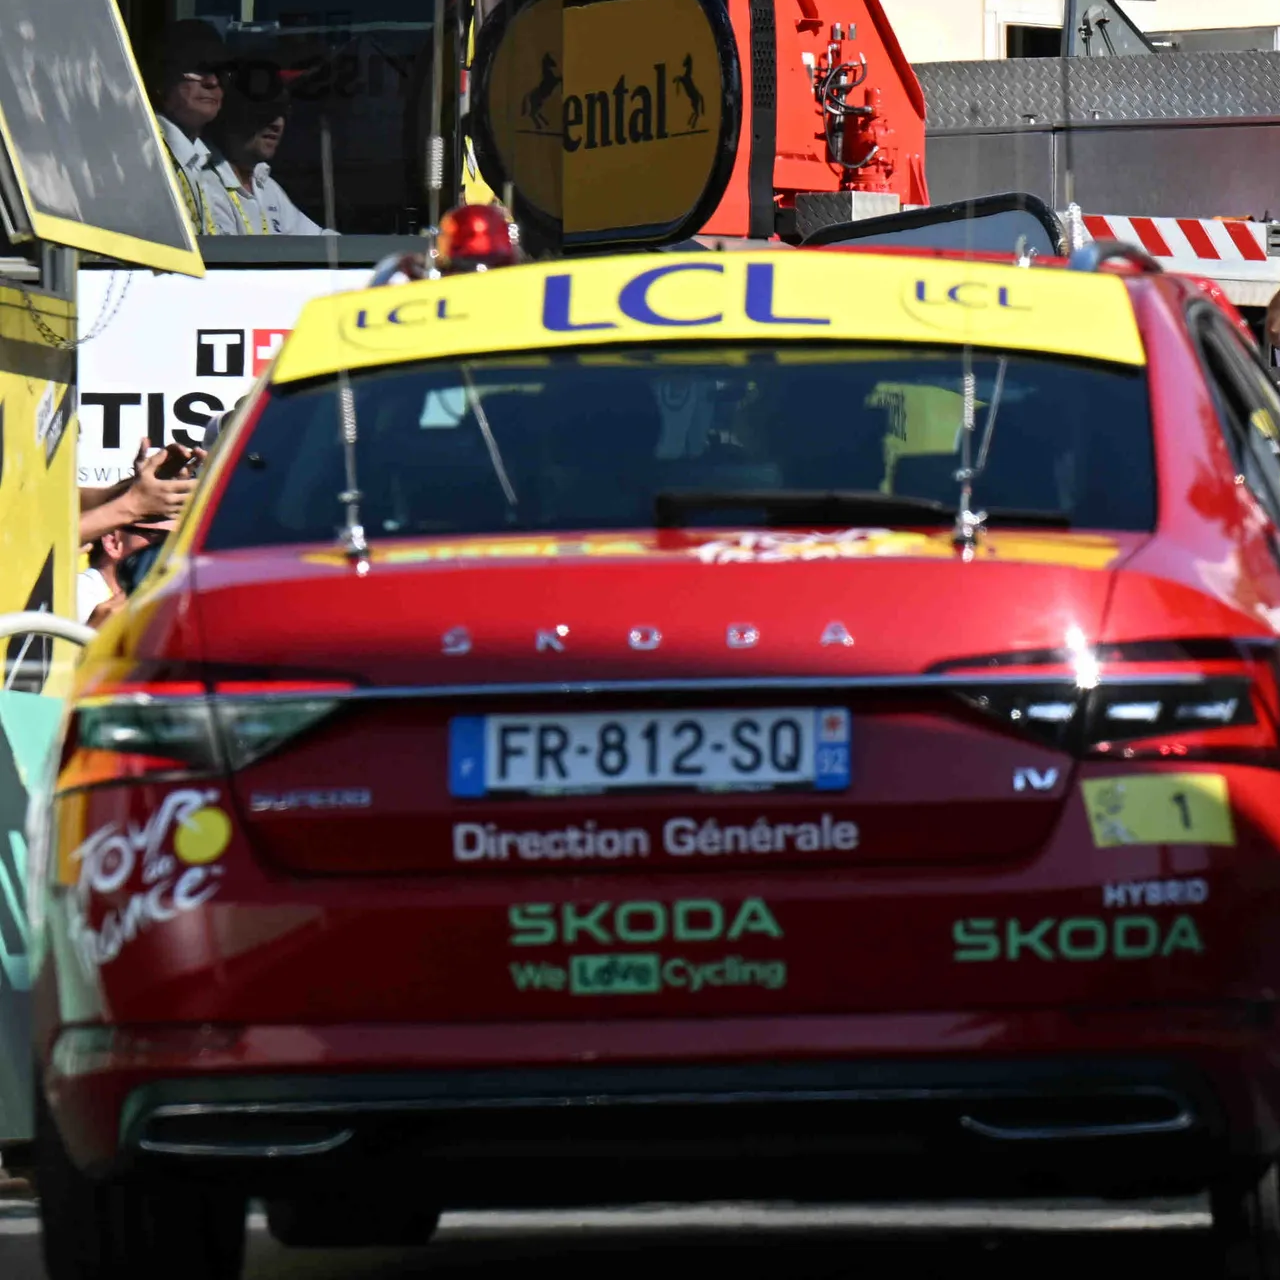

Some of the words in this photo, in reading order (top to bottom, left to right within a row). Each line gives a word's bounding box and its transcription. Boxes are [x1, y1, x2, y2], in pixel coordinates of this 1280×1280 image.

[356, 298, 468, 330] LCL
[542, 263, 831, 332] LCL
[914, 280, 1033, 310] LCL
[499, 718, 803, 781] FR-812-SQ
[1172, 792, 1192, 830] 1
[453, 821, 650, 862] Direction
[664, 814, 860, 857] Générale
[508, 896, 785, 947] SKODA
[953, 914, 1203, 962] SKODA
